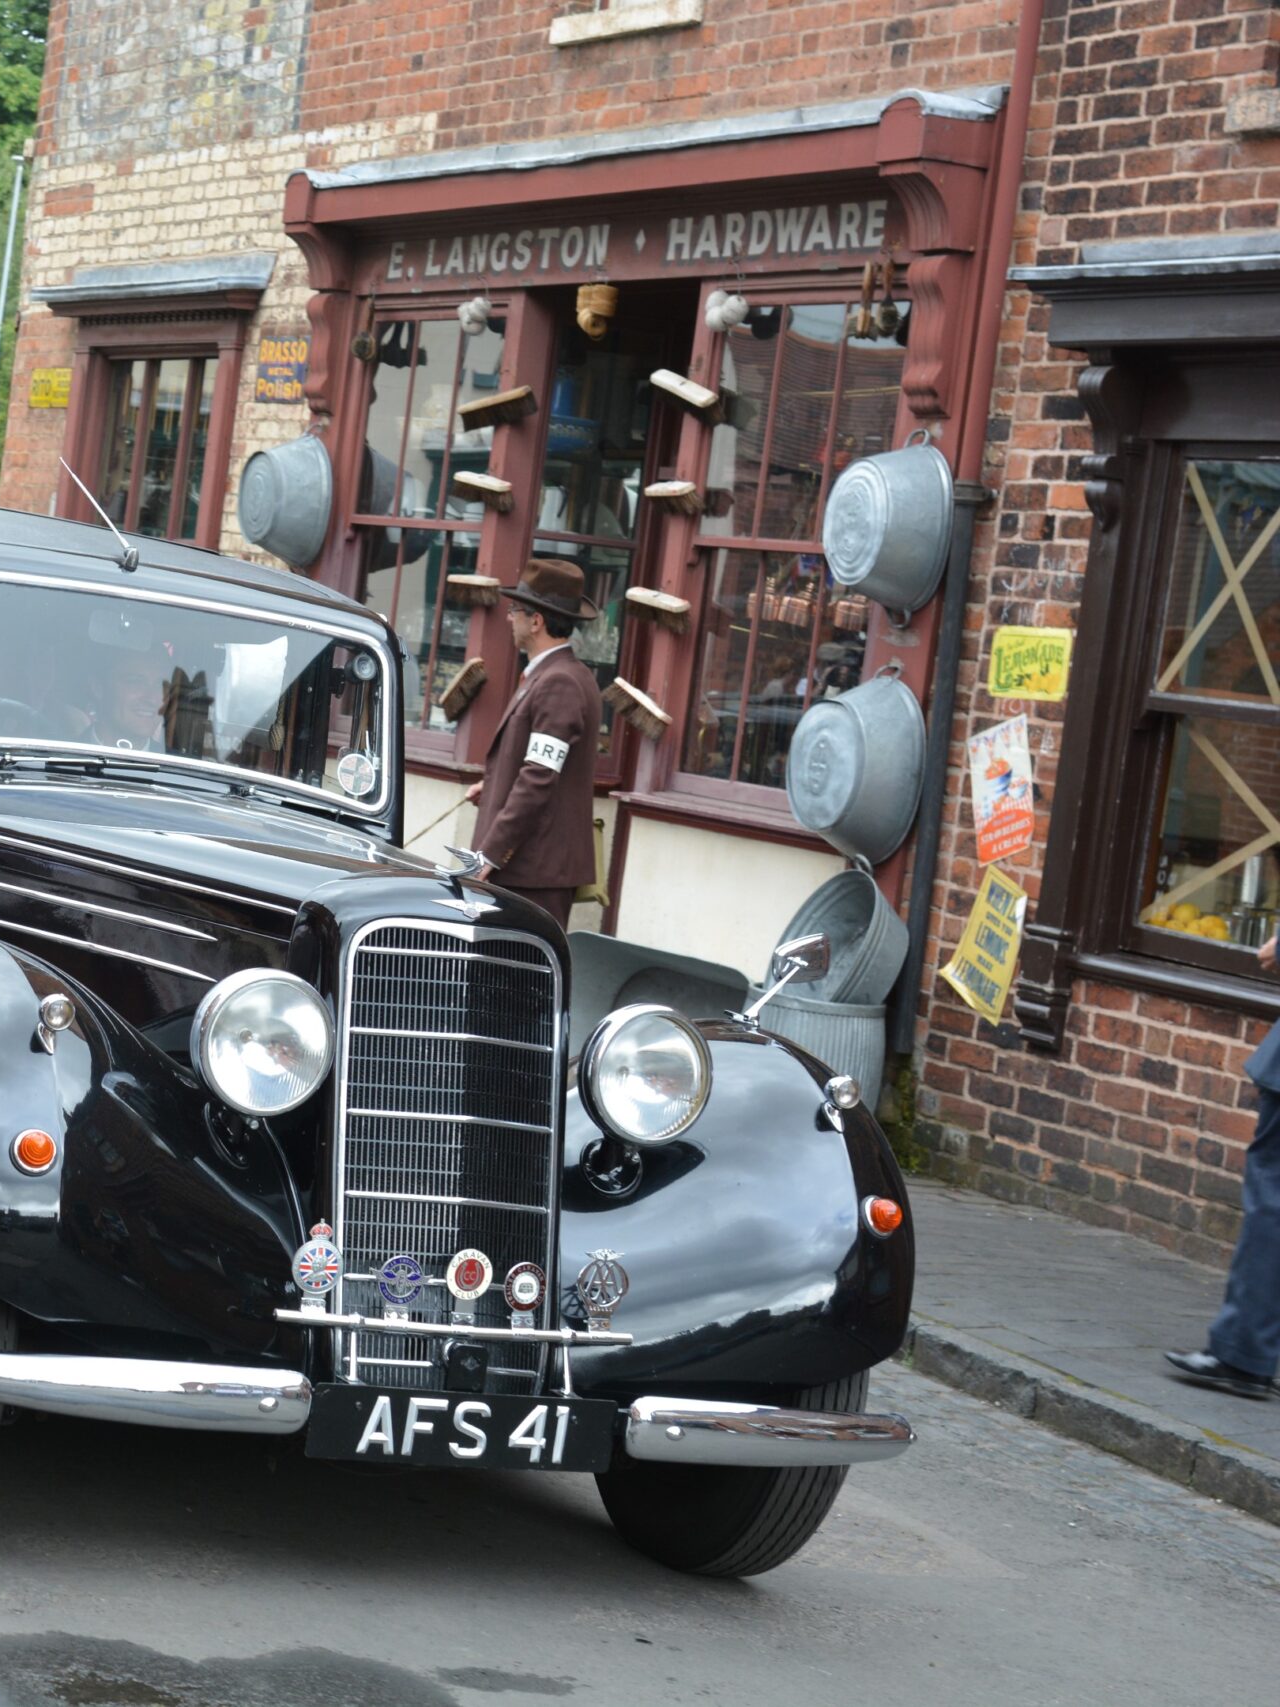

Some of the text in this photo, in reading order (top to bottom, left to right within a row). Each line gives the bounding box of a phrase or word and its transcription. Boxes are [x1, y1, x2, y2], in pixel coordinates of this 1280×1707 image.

[386, 199, 889, 281] E. LANGSTON HARDWARE
[260, 339, 308, 363] BRASSO
[256, 378, 303, 400] Polish
[531, 741, 566, 762] ARP
[451, 1251, 491, 1269] CARAVAN
[455, 1290, 480, 1299] CLUB
[355, 1395, 570, 1465] AFS 41
